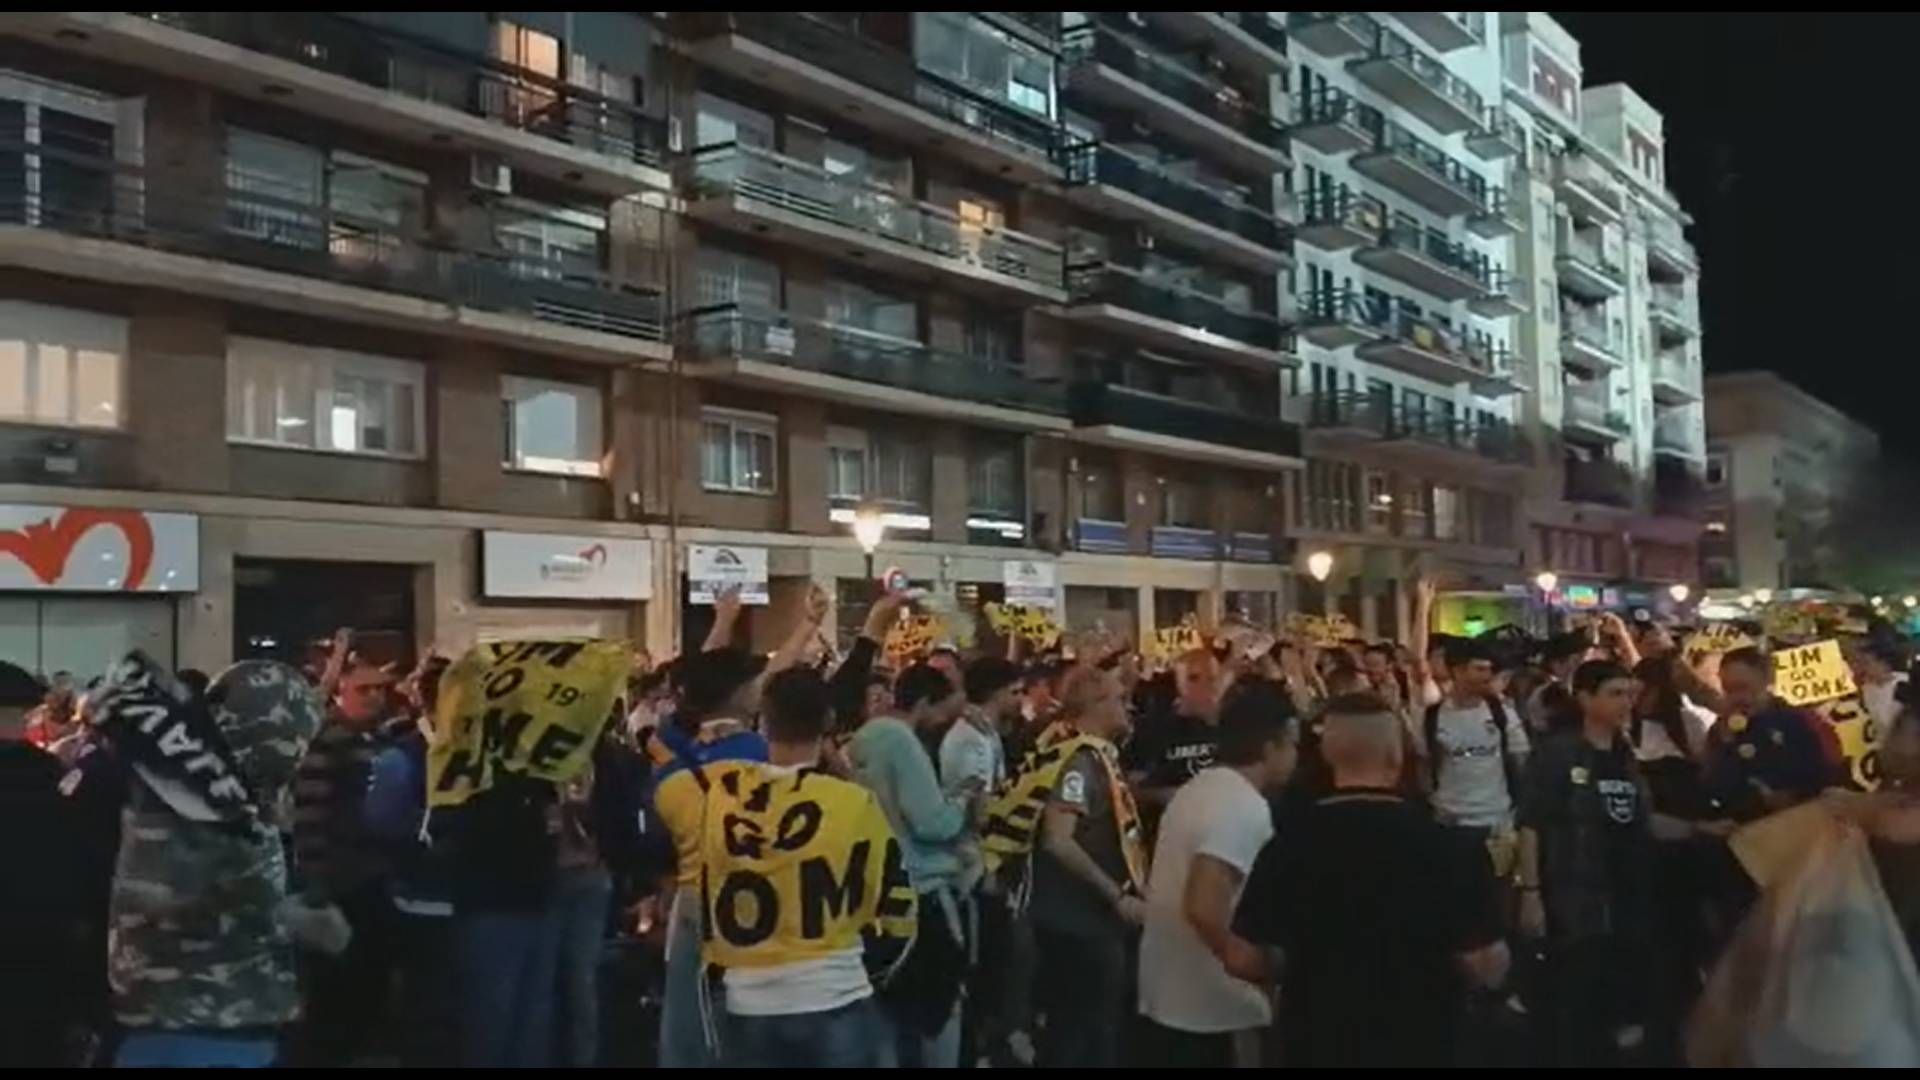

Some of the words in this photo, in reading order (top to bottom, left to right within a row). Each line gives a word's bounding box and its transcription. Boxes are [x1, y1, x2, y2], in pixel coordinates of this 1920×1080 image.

[1773, 647, 1822, 670] LIM
[1790, 668, 1816, 681] GO
[723, 800, 823, 858] GO
